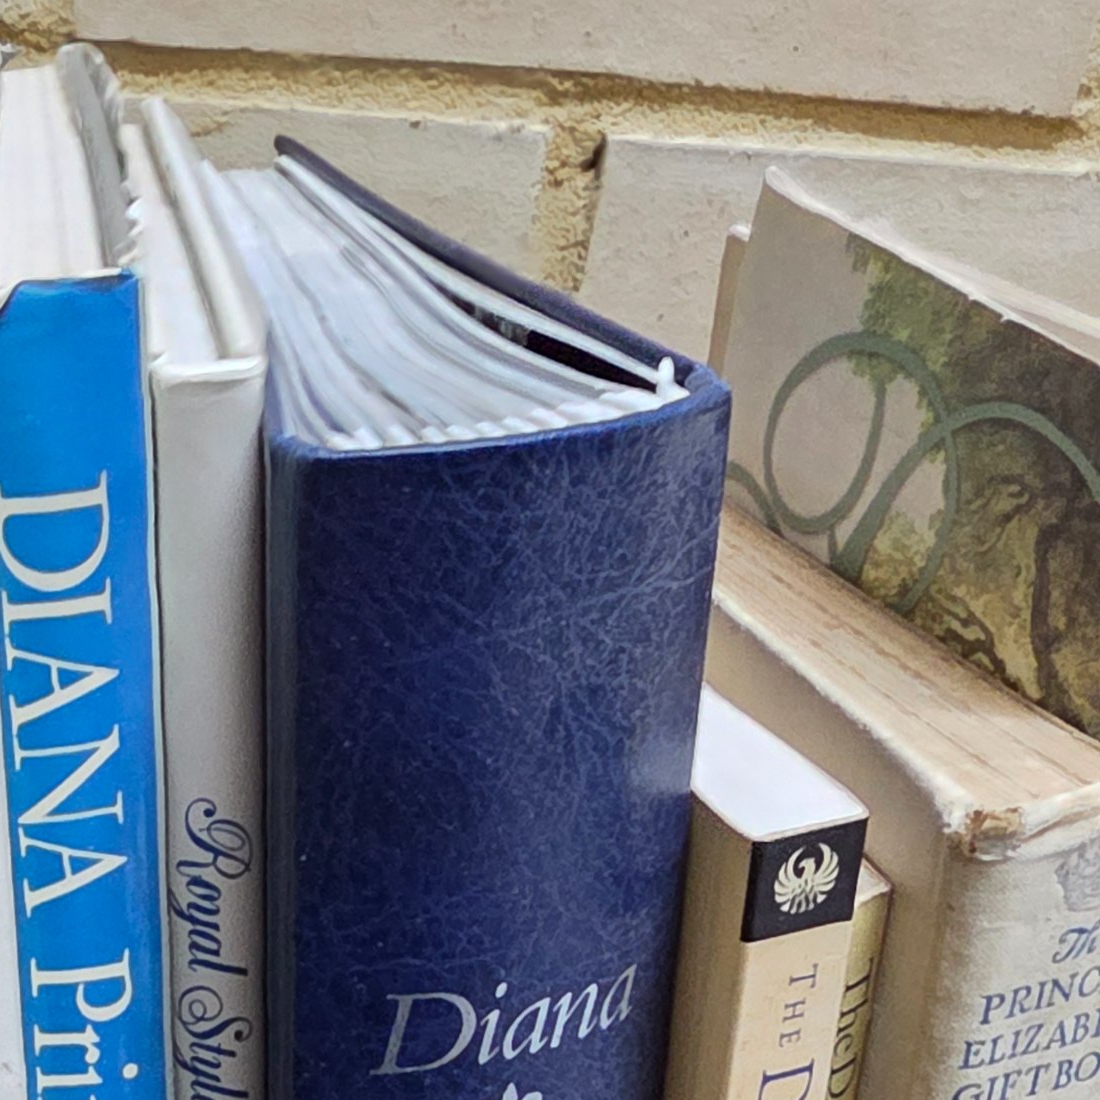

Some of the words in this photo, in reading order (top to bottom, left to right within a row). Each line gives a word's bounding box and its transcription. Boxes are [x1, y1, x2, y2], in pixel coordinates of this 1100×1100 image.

[168, 798, 253, 977] Royal
[369, 963, 638, 1076] Diana
[778, 962, 819, 1049] THE
[834, 957, 874, 1053] The
